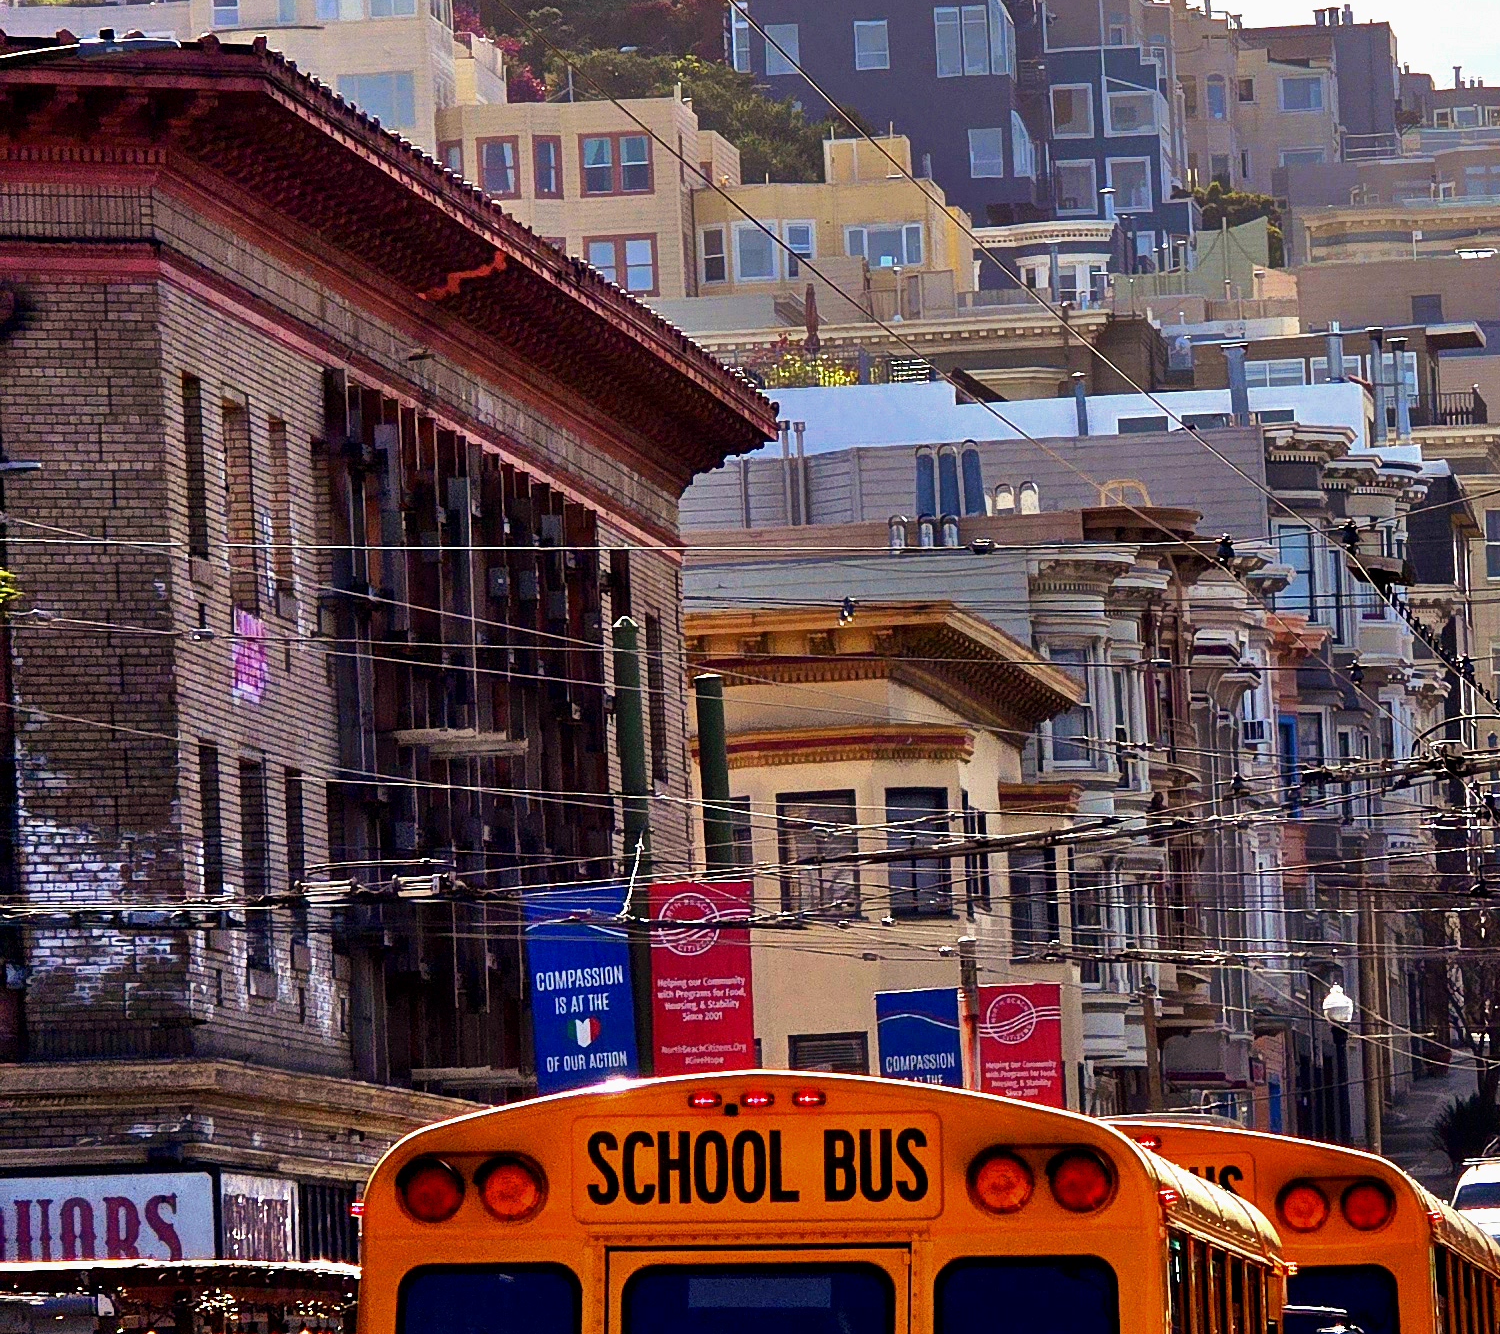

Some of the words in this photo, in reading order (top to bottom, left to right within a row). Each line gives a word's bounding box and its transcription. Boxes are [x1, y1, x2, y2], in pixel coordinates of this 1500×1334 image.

[536, 965, 623, 991] COMPASSION
[657, 978, 687, 989] Helping
[703, 976, 745, 986] Community
[555, 997, 567, 1014] IS
[571, 995, 585, 1013] AT
[588, 993, 610, 1011] THE
[675, 989, 711, 1000] Programs
[713, 988, 724, 997] for
[682, 1012, 702, 1021] Since
[704, 1012, 722, 1020] 2001
[546, 1056, 560, 1073] OF
[563, 1054, 586, 1071] OUR
[589, 1051, 628, 1069] ACTION
[886, 1052, 955, 1073] COMPASSION
[587, 1130, 800, 1205] SCHOOL
[823, 1128, 929, 1203] BUS
